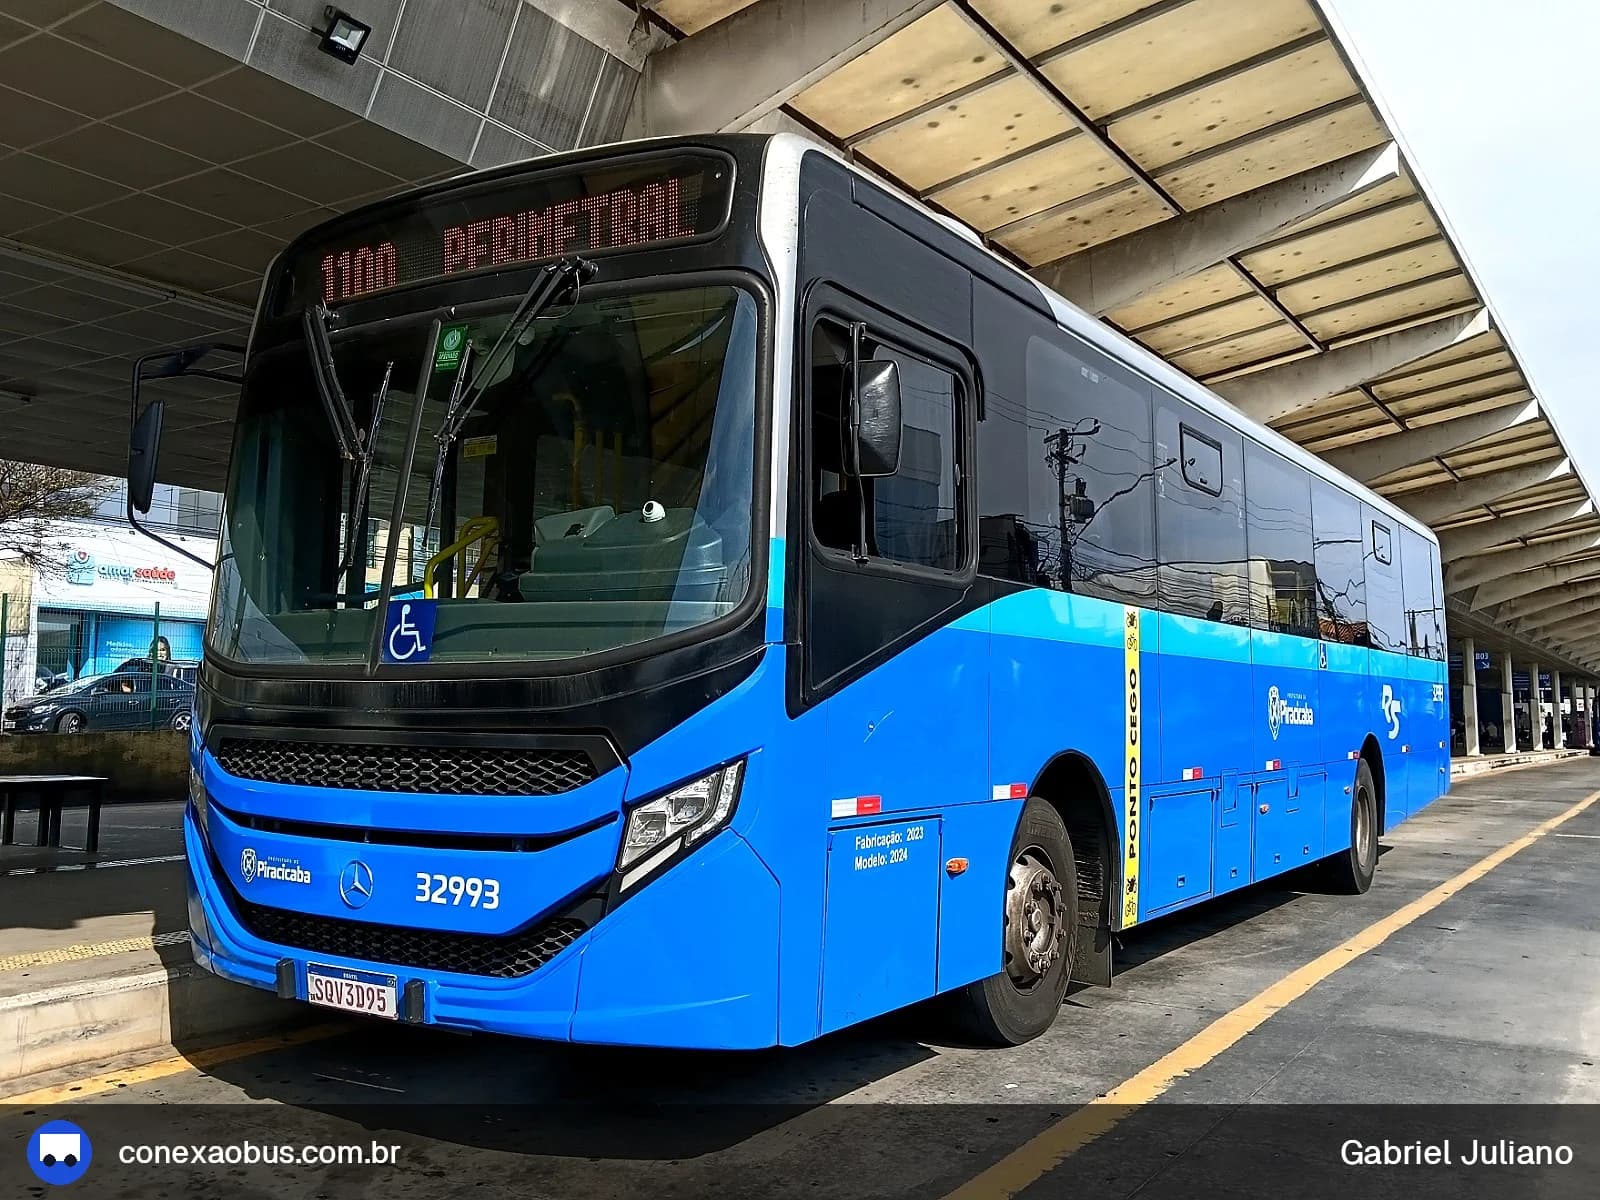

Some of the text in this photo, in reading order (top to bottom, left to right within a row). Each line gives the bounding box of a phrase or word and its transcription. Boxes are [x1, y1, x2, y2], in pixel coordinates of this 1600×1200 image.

[321, 178, 694, 302] 1100 PERIMETRAL
[1280, 699, 1314, 725] Piracicaba
[1129, 668, 1138, 859] PONTO CEGO
[855, 826, 924, 850] Fabricação: 2023
[257, 860, 311, 884] Piracicaba
[854, 847, 908, 871] Modelo: 2024
[415, 872, 500, 910] 32993
[314, 978, 387, 1012] SQV3D95
